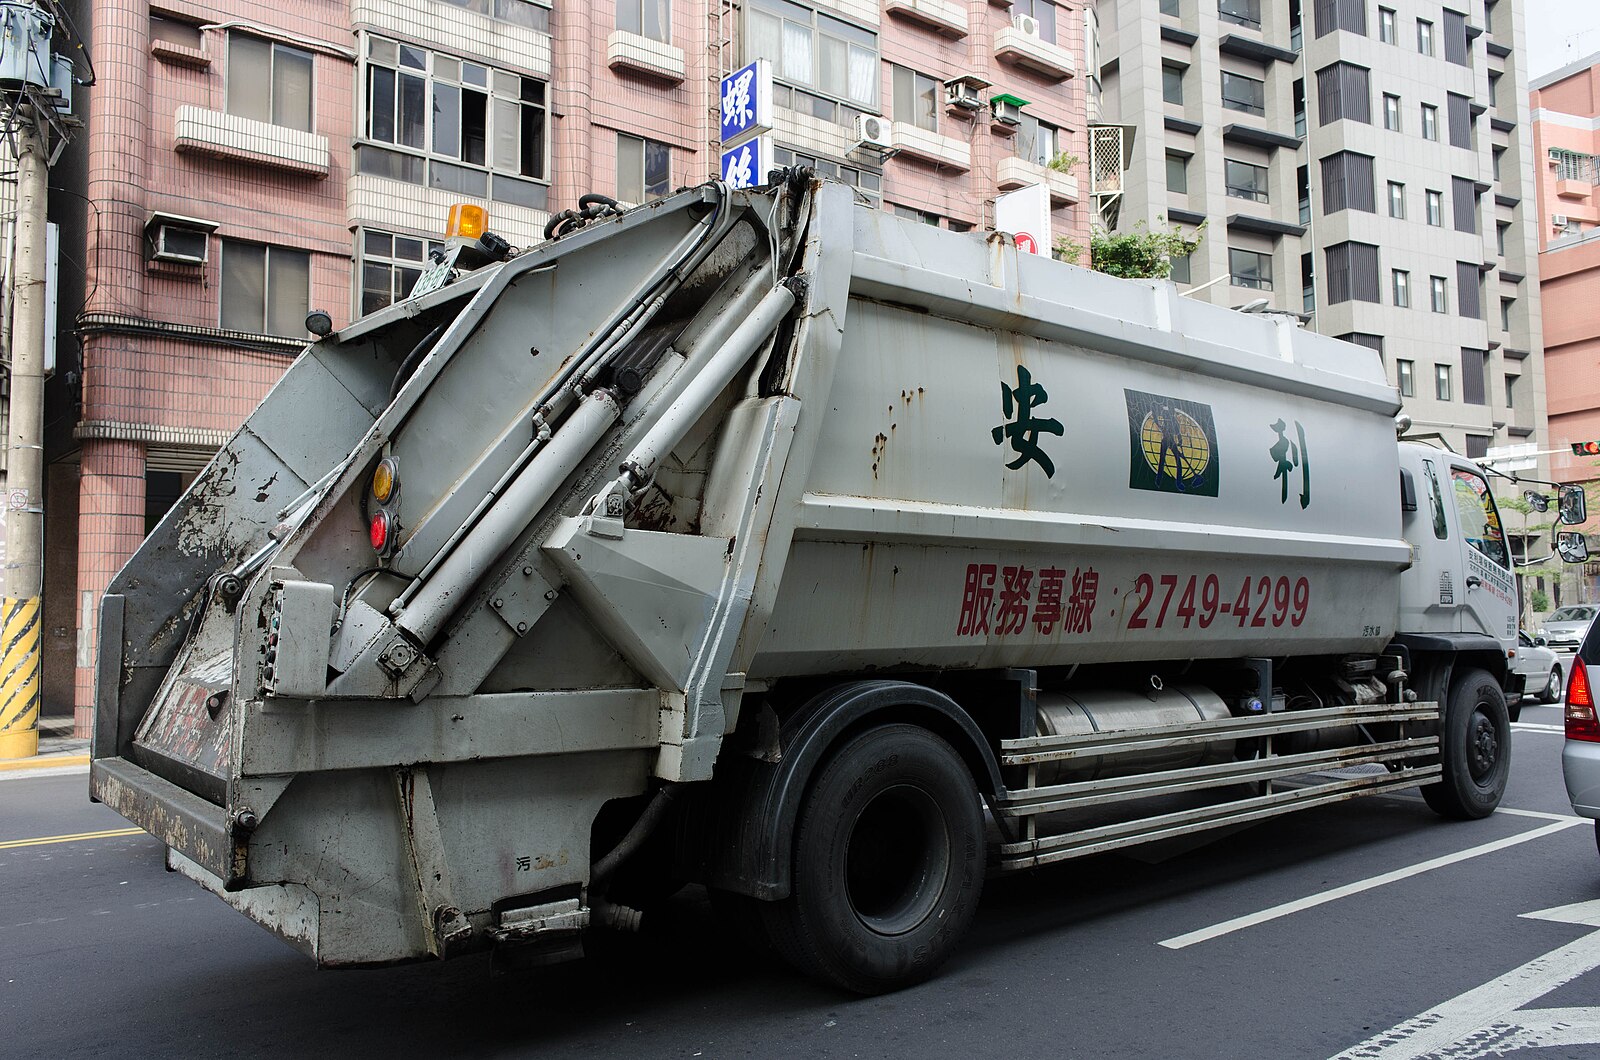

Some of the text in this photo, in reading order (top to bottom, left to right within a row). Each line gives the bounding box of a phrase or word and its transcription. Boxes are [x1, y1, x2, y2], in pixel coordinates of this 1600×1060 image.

[991, 364, 1311, 510] 安 利
[1127, 573, 1310, 629] 2749-4299
